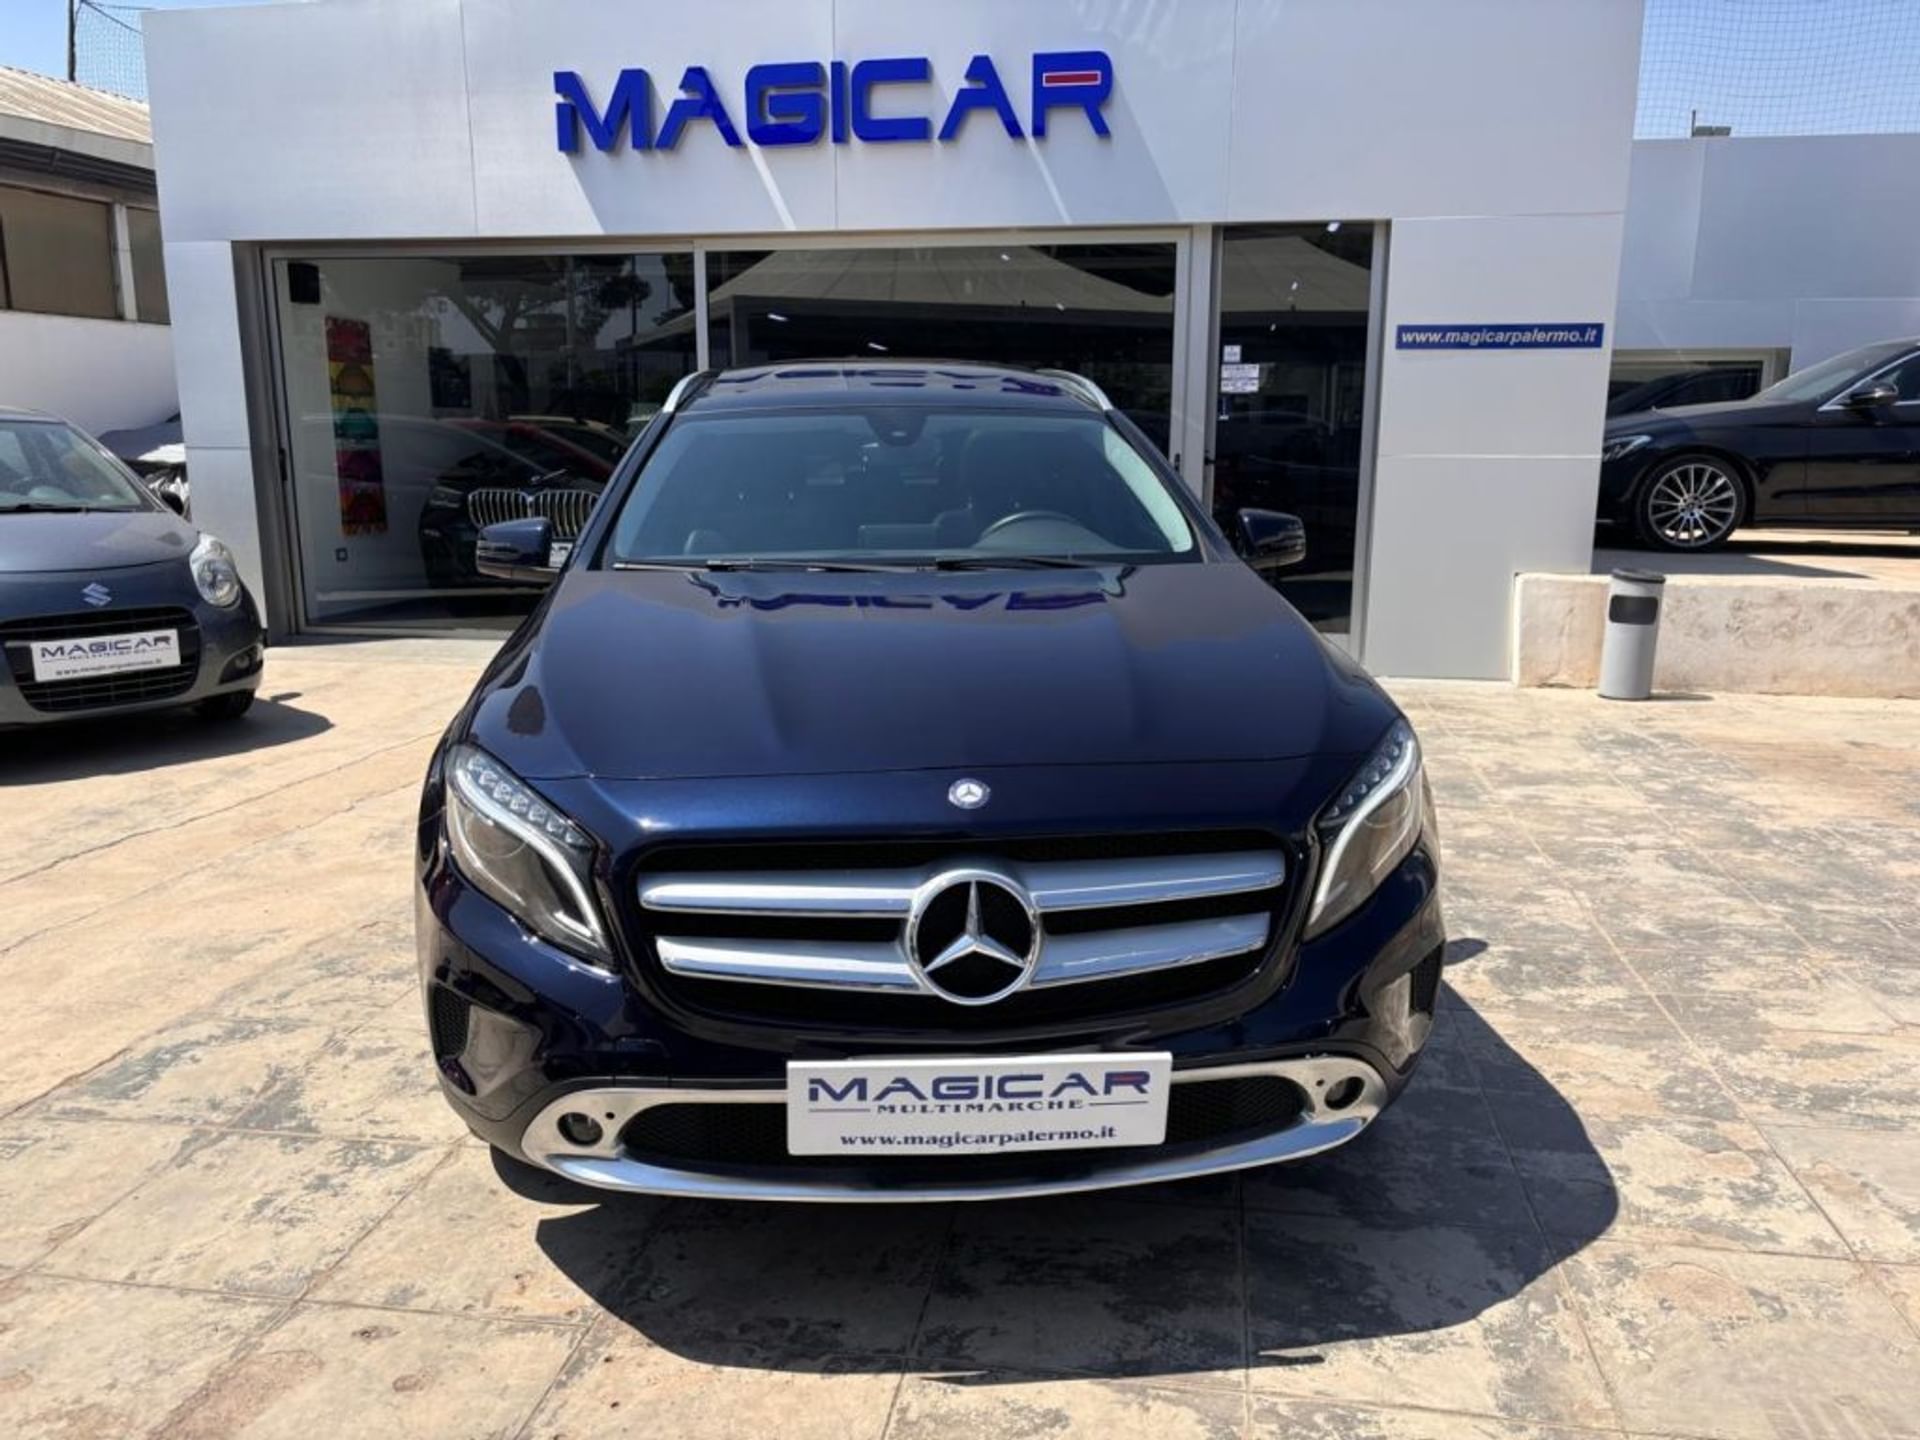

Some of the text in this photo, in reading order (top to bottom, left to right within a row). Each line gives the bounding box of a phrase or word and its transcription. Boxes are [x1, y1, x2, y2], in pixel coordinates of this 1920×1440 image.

[553, 50, 1113, 153] MAGICAR
[1401, 327, 1598, 346] www.magicarpalermo.it
[41, 636, 171, 658] MAGICAR
[808, 1070, 1151, 1102] MAGICAR
[877, 1099, 1084, 1114] MULTIMARCHE
[840, 1125, 1117, 1149] www.magicarpalermo.it
